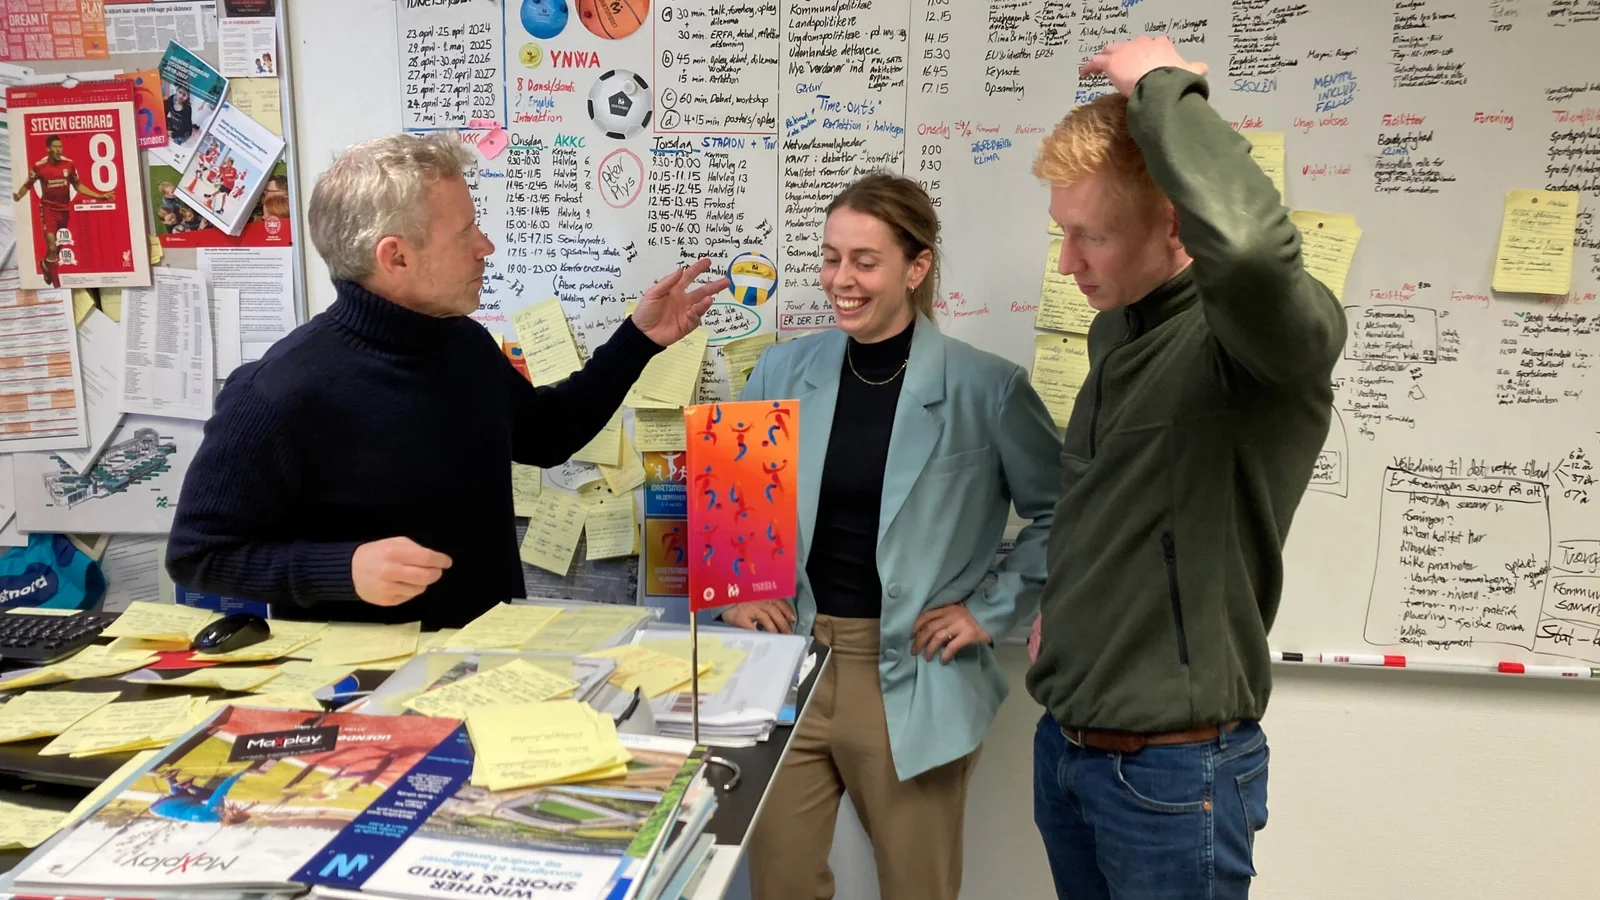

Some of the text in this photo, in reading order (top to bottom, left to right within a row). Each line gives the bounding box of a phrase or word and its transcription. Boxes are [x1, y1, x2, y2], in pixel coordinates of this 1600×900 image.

[81, 1, 104, 13] PLAY
[9, 13, 48, 26] DREAM IT
[676, 8, 689, 19] 30
[925, 10, 952, 22] 12.15
[468, 22, 491, 35] 2024
[788, 16, 857, 32] Landspolitikere
[678, 30, 690, 40] 30
[924, 32, 949, 44] 14.15
[469, 39, 492, 50] 2025
[468, 52, 491, 64] 2026
[676, 53, 690, 65] 45
[840, 43, 881, 63] deltagere
[923, 48, 951, 60] 15.30
[550, 50, 601, 69] YNWA
[474, 68, 496, 79] 2027
[678, 74, 687, 83] 15
[985, 65, 1020, 80] Keynote
[473, 83, 493, 94] 2028
[921, 82, 949, 94] 17.15
[1230, 77, 1278, 93] SKOLEN
[473, 93, 496, 107] 2029
[679, 93, 692, 104] 60
[471, 109, 496, 119] 2030
[31, 114, 113, 132] STEVEN GERRARD
[1293, 117, 1315, 134] Unge
[1472, 111, 1514, 131] Forening
[511, 133, 586, 151] Onsdag AKKC
[652, 136, 745, 154] Torsdag STADION
[89, 133, 118, 192] 8
[737, 160, 747, 169] 12
[973, 152, 1000, 165] KLIMA
[649, 170, 701, 181] 10.15-11.15
[738, 174, 748, 183] 13
[649, 182, 702, 195] 11.45-12.45
[736, 186, 746, 195] 14
[506, 193, 550, 203] 12.45-13.45
[648, 196, 736, 210] 12.45-13.45 Frokost
[648, 209, 697, 220] 13.45-14.45
[736, 212, 745, 221] 15
[505, 219, 550, 230] 15.00-16.00
[648, 222, 701, 234] 15.00-16.00
[735, 224, 744, 233] 16
[59, 230, 69, 239] 710
[785, 233, 793, 242] 2
[60, 250, 72, 259] 186
[783, 315, 826, 326] ER DER ET
[407, 865, 578, 892] SPORT & FRITID
[429, 879, 533, 899] WINTHER
